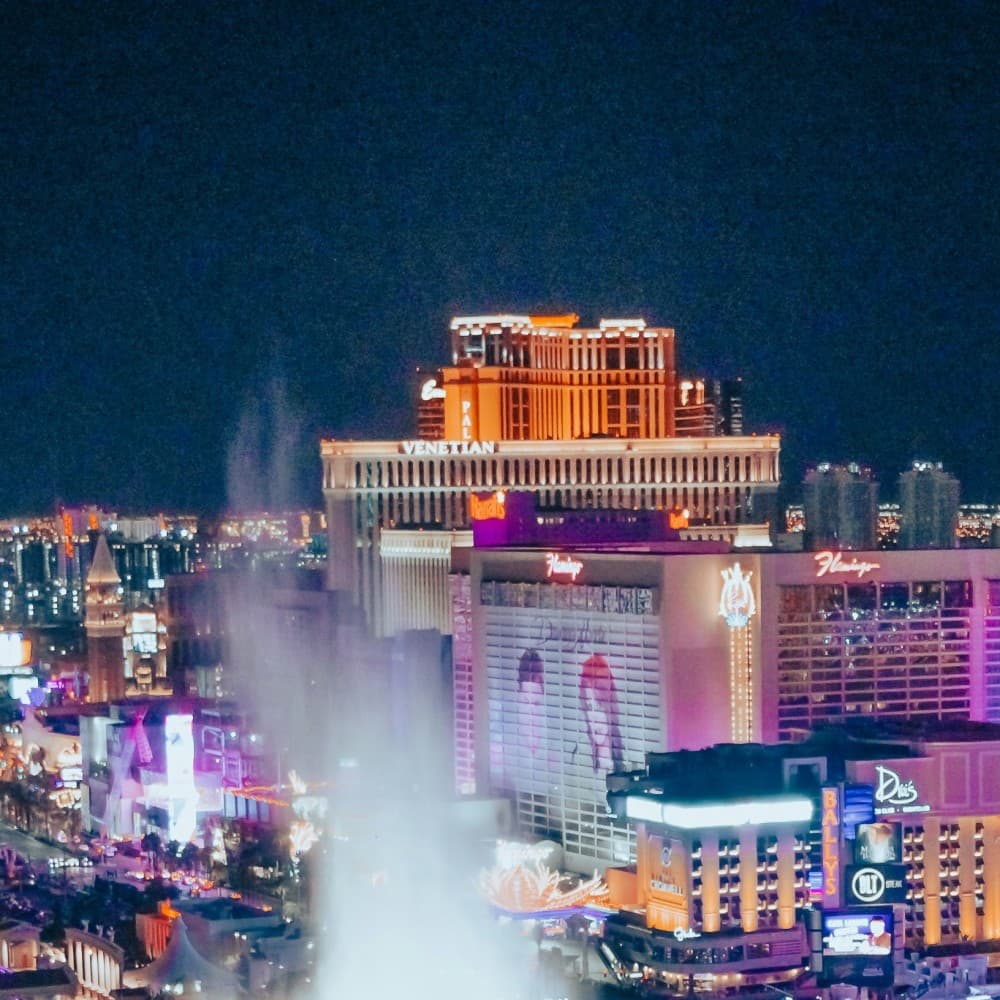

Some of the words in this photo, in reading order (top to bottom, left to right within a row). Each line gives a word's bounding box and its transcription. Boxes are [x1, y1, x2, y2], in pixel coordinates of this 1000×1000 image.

[461, 401, 471, 440] PAL
[402, 441, 495, 455] VENETIAN
[814, 551, 880, 578] Flamingo
